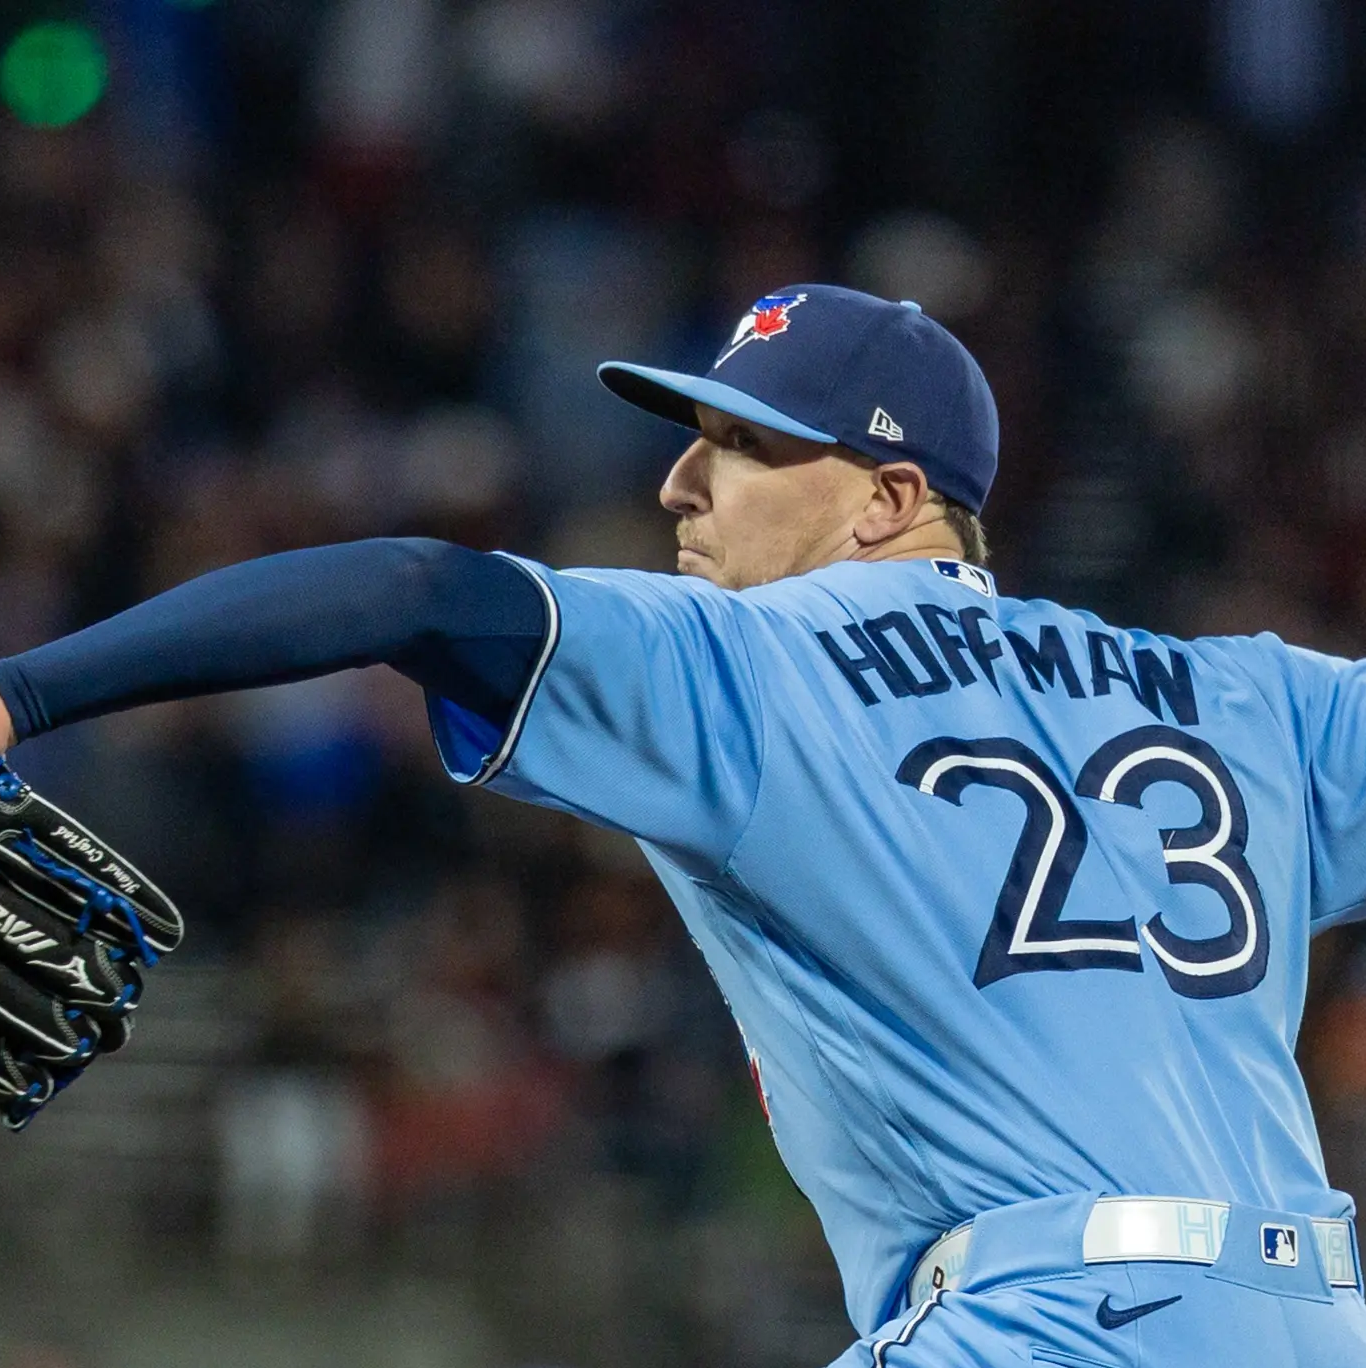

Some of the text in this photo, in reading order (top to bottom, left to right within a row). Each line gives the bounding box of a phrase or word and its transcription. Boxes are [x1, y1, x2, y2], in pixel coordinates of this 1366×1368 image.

[815, 603, 1200, 727] HOFFMAN
[49, 825, 141, 894] Hand Crafted
[894, 724, 1271, 1000] 23
